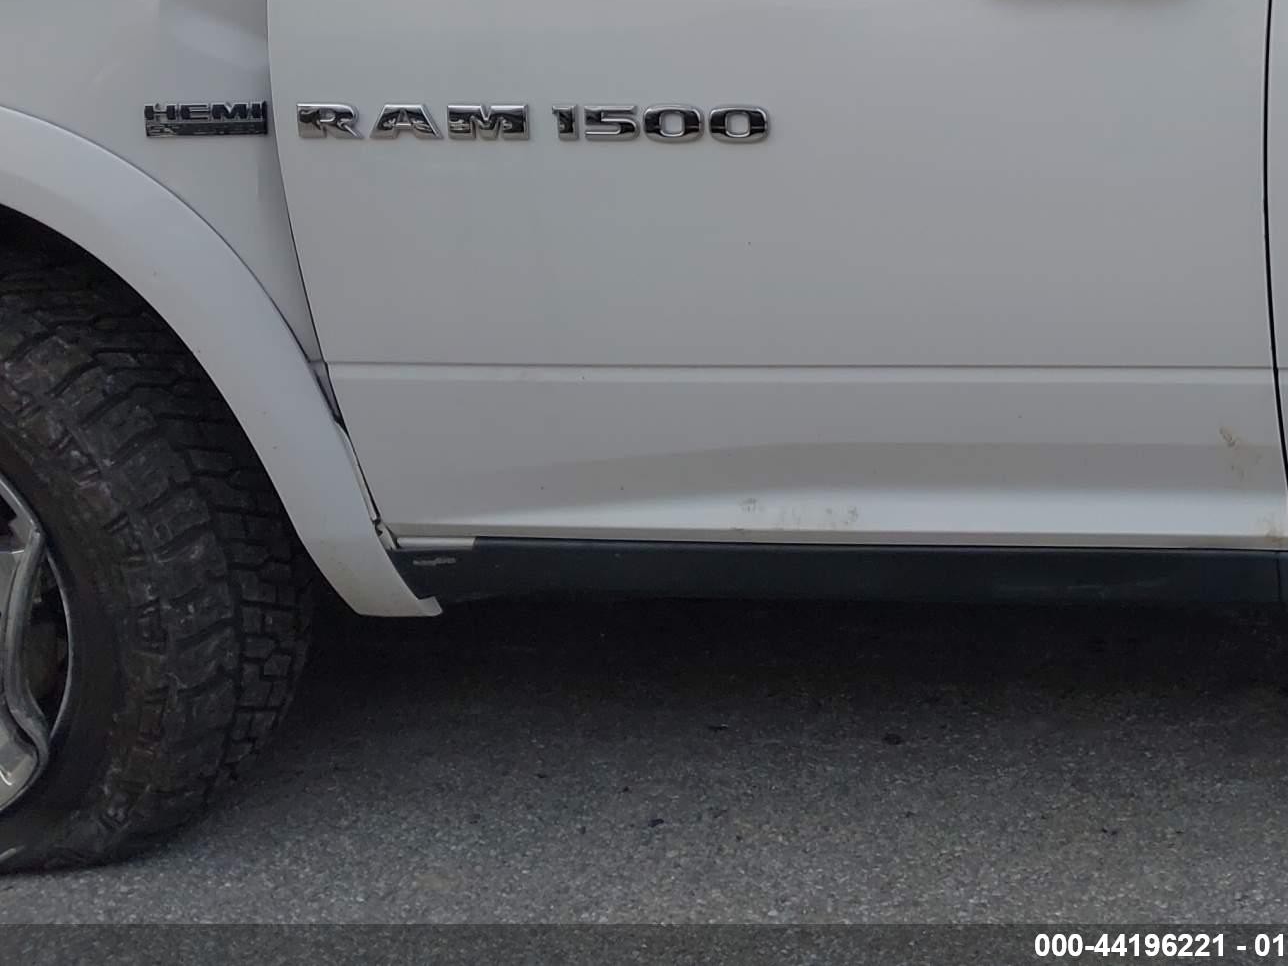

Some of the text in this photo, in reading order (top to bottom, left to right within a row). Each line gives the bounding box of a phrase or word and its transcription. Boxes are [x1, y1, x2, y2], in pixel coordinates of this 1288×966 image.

[144, 101, 268, 121] HEMI
[296, 103, 769, 144] RAM 1500
